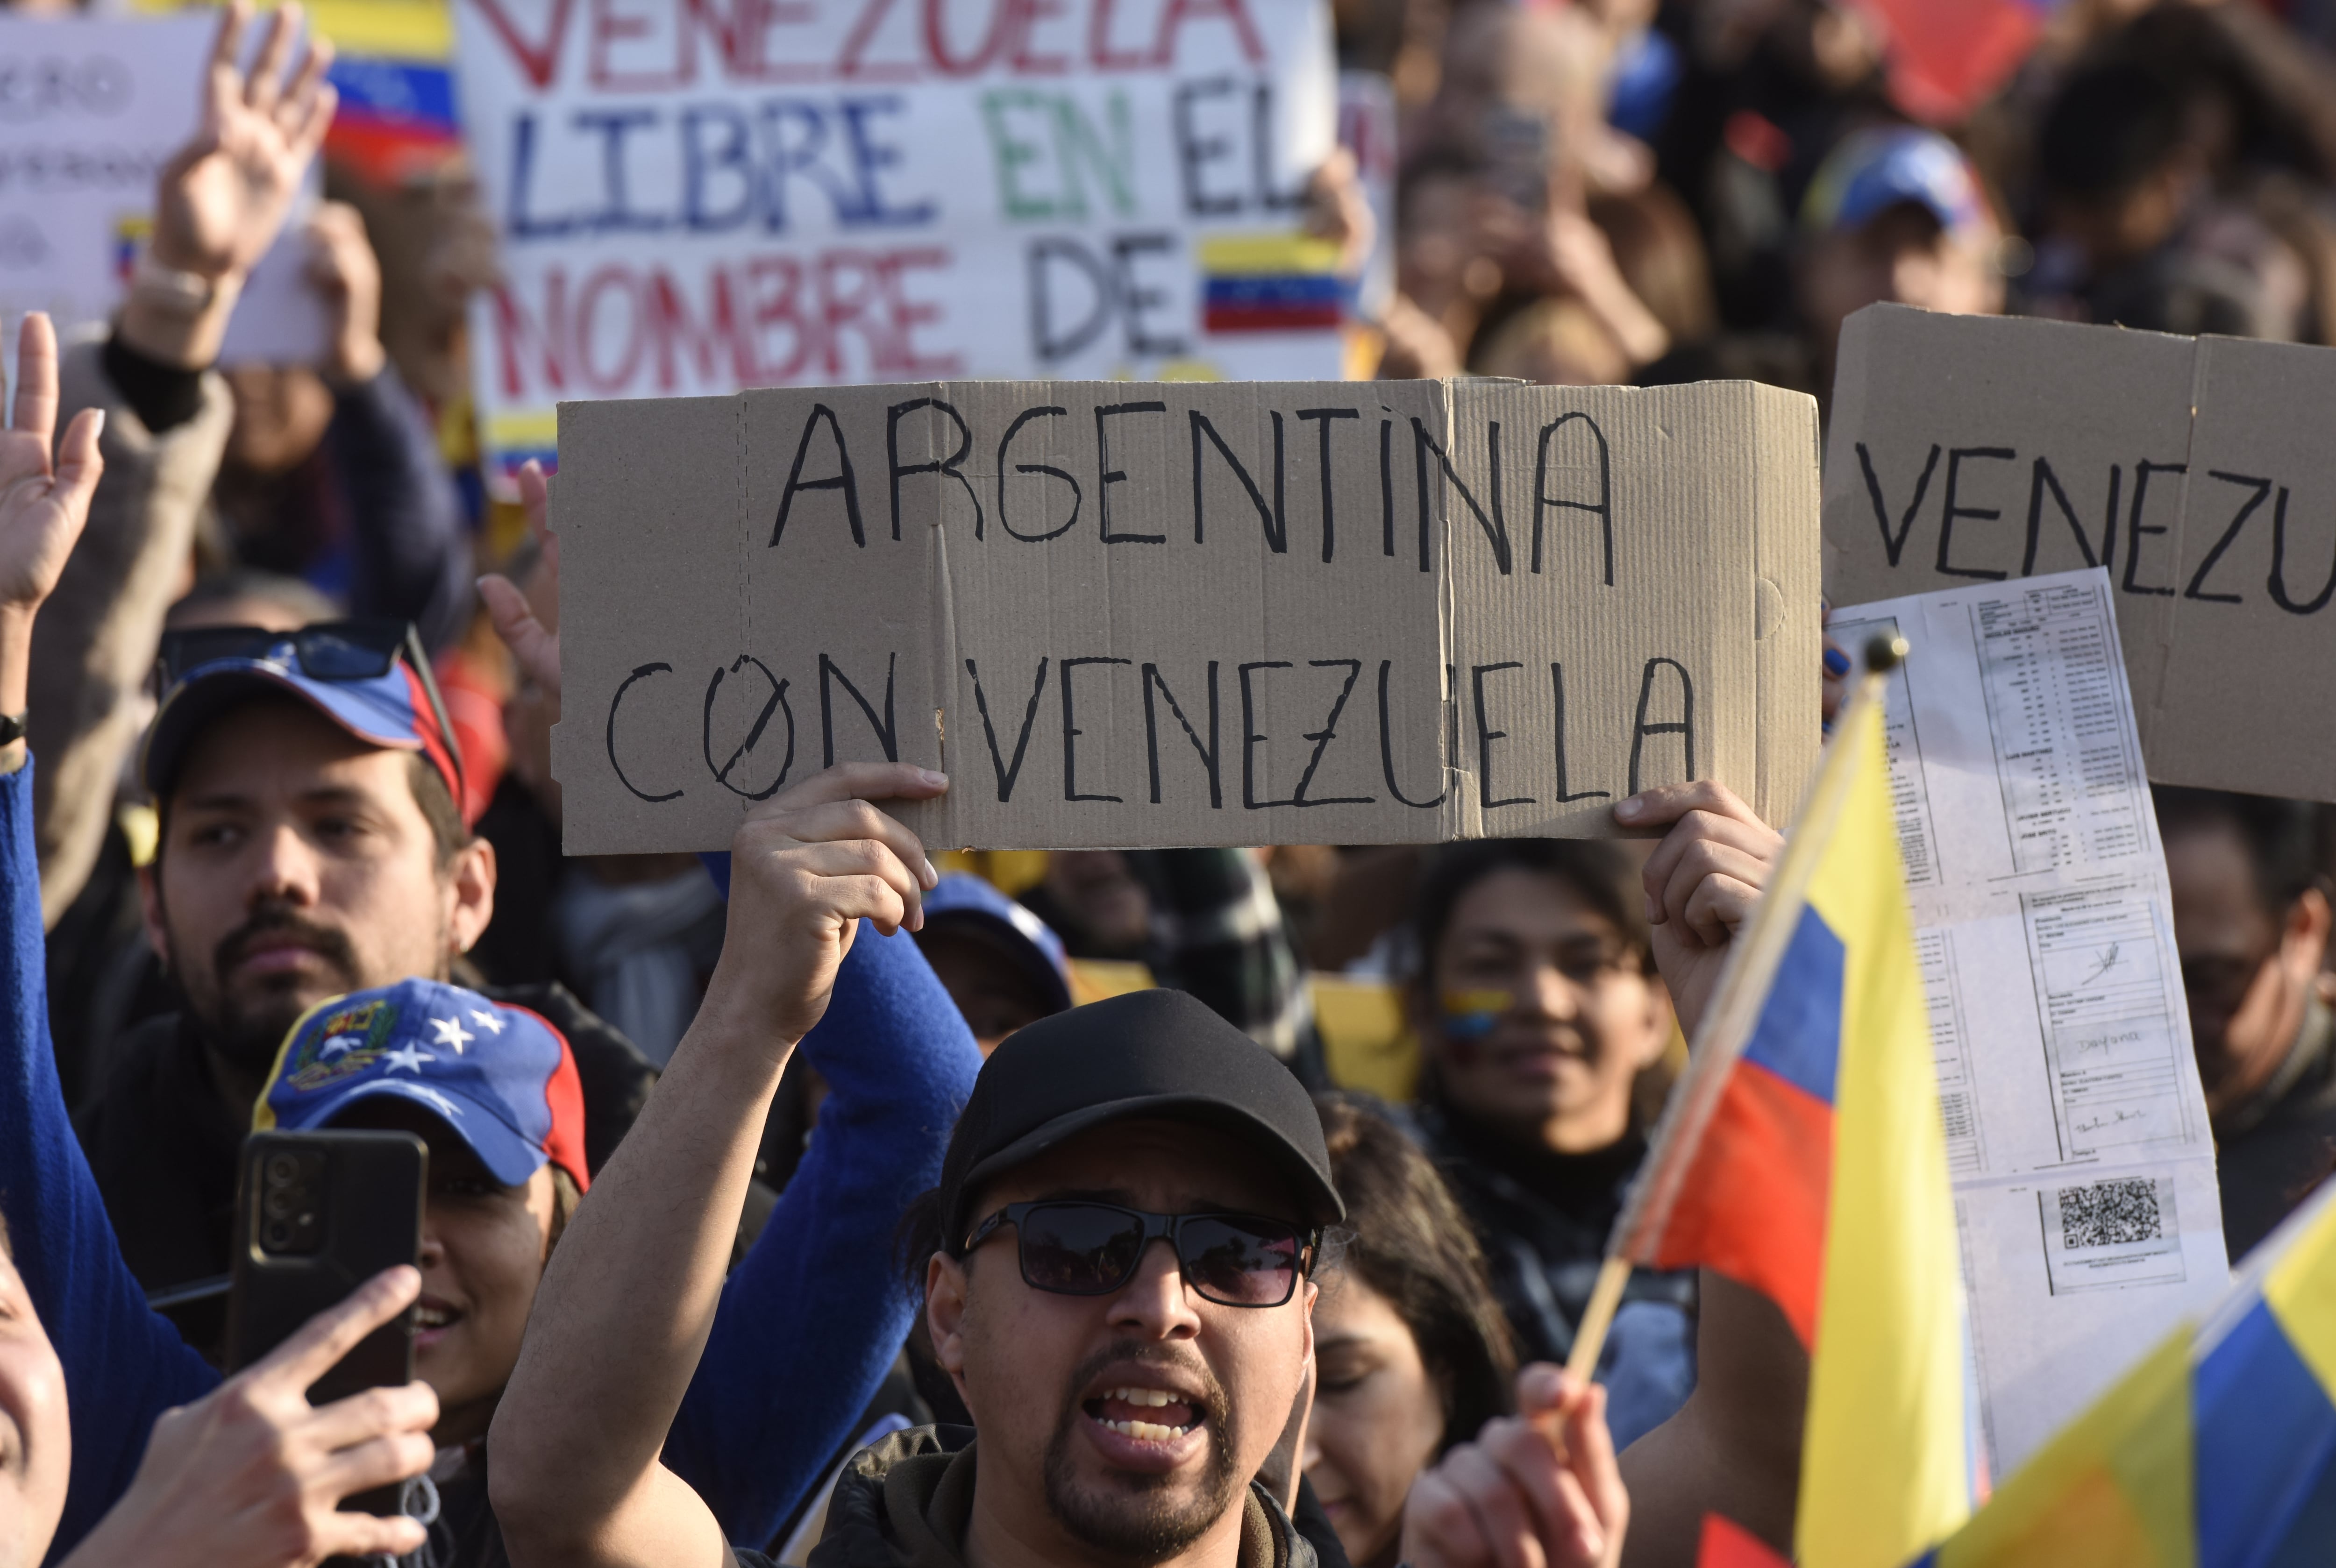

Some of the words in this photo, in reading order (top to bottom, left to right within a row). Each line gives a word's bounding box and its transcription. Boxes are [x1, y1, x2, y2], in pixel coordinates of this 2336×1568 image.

[507, 91, 937, 241] LIBRE
[979, 87, 1138, 220] EN
[1172, 76, 1309, 216] EL
[493, 244, 963, 403] NOMBRE
[1029, 231, 1190, 364] DE
[965, 657, 1696, 810] VENEZUELA
